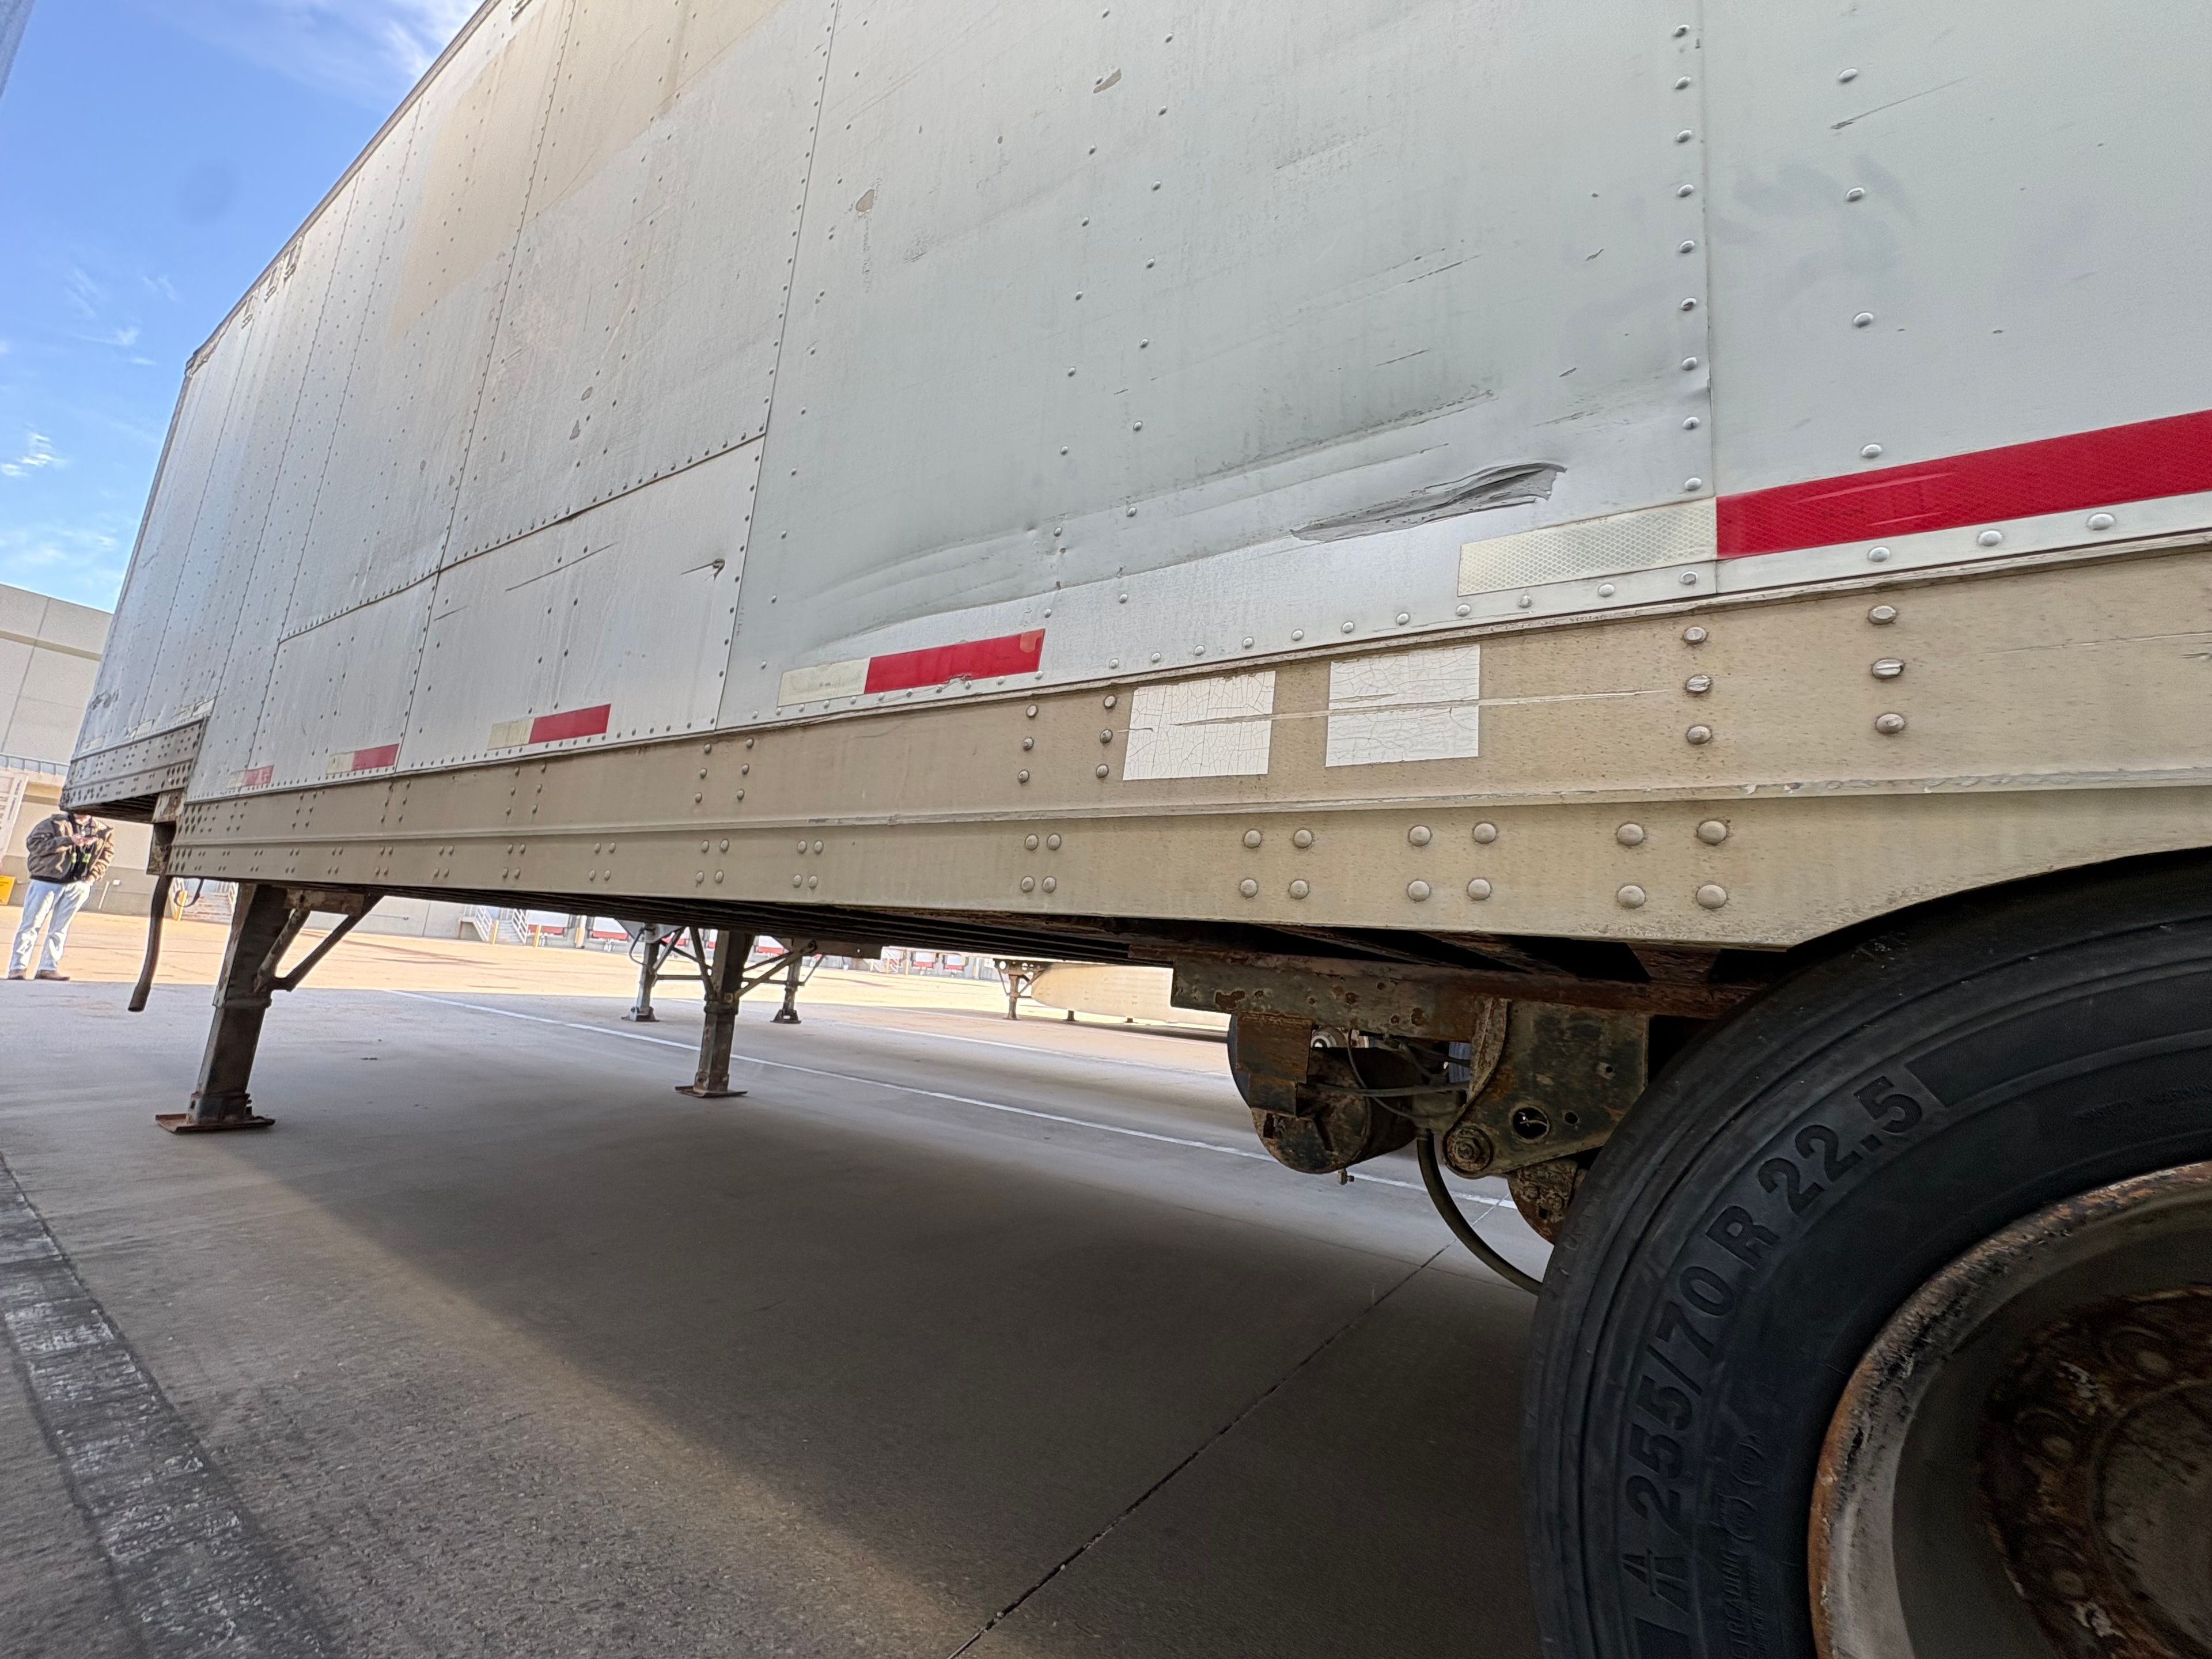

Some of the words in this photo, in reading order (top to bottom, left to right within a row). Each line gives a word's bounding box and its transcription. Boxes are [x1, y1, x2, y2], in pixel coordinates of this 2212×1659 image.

[1626, 1266, 1735, 1536] 255/70
[1706, 1205, 1781, 1270] R
[1758, 1075, 1923, 1217] 22.5
